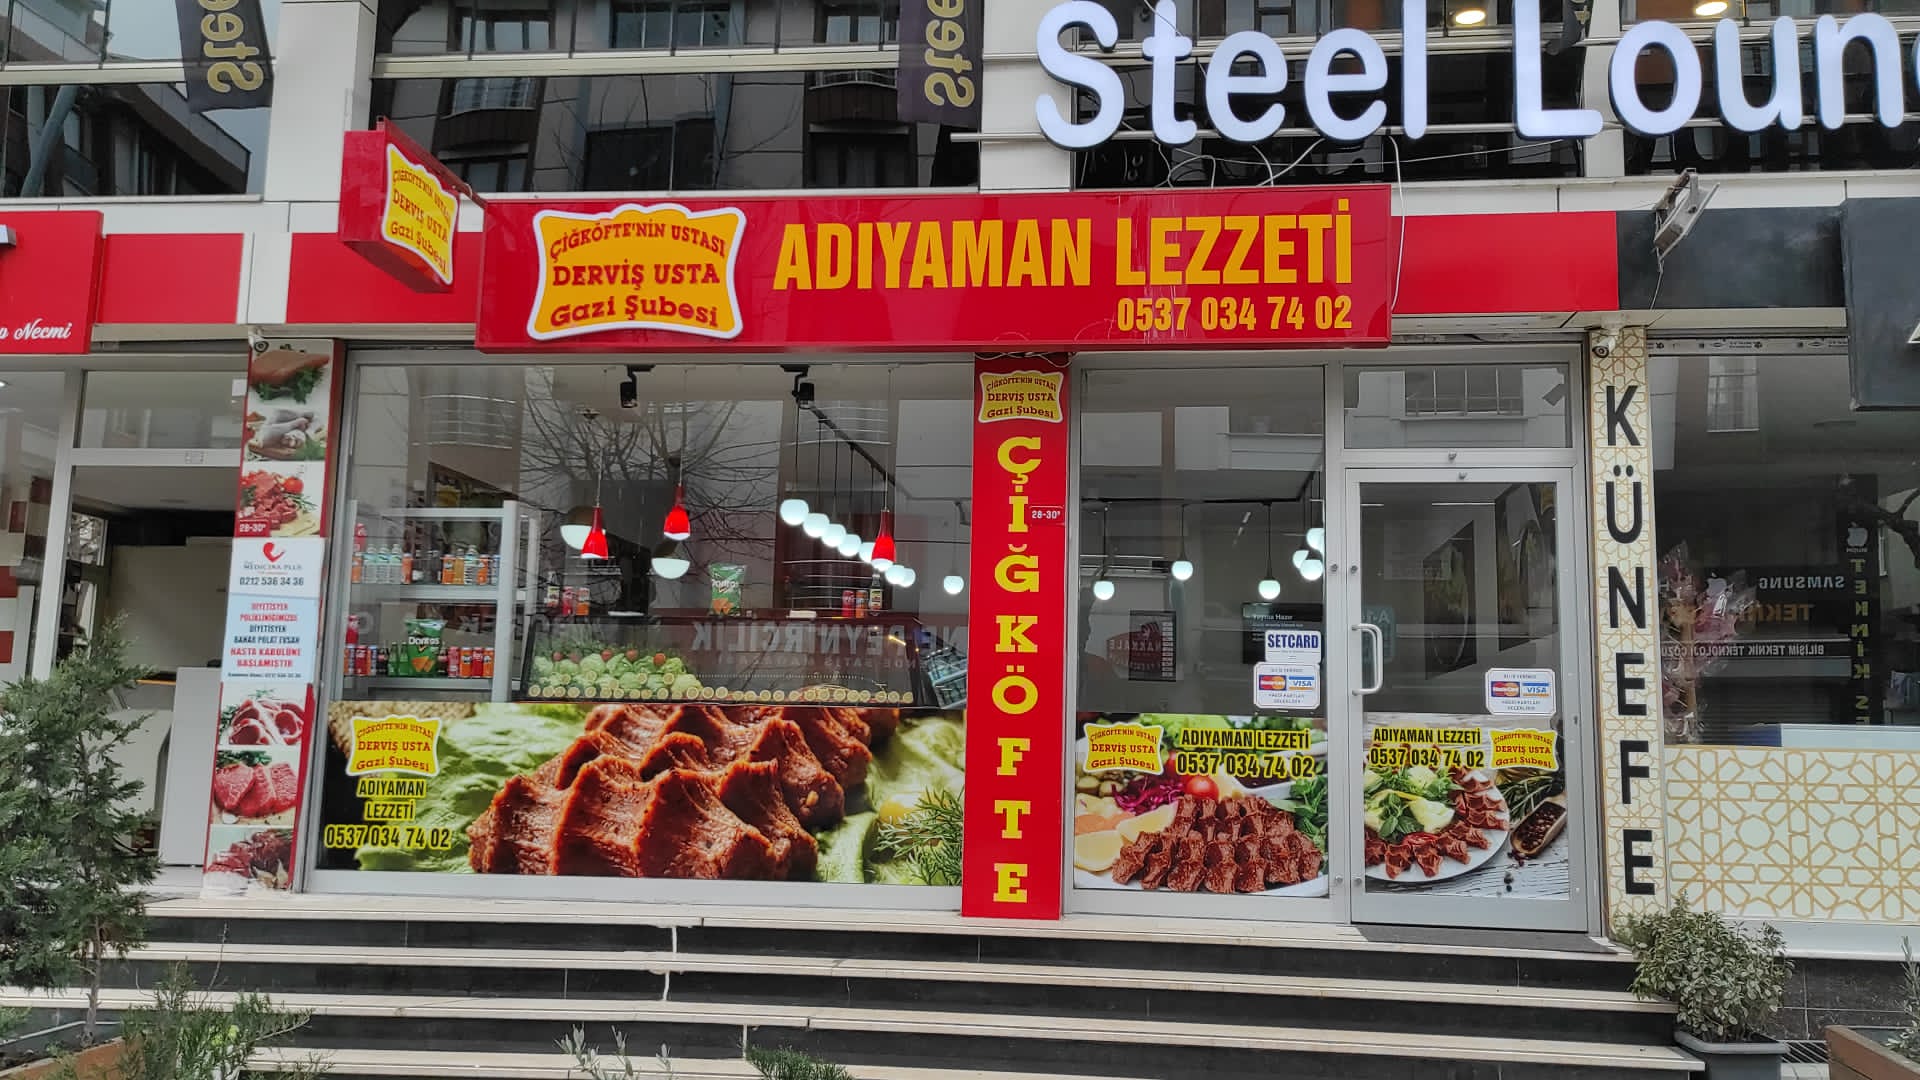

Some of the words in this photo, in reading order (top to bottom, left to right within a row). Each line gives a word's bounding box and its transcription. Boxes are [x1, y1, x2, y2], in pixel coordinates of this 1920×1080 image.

[1035, 0, 1427, 148] Steel
[1512, 0, 1920, 139] Loun
[393, 189, 424, 228] DERVİŞ
[426, 209, 448, 243] USTA
[391, 221, 414, 241] Gazi
[550, 218, 666, 263] ÇİĞKÖFTE'NİN
[671, 223, 726, 259] USTASI
[773, 217, 1092, 290] ADIYAMAN
[1115, 198, 1352, 286] LEZZETİ
[552, 259, 645, 290] DERVİŞ
[654, 263, 720, 285] USTA
[551, 296, 616, 327] Gazi
[625, 295, 719, 327] Şubesi
[1118, 297, 1190, 332] 0537
[1201, 297, 1256, 331] 034
[1267, 296, 1304, 331] 74
[1315, 295, 1352, 330] 02
[14, 318, 73, 341] Necmi
[988, 392, 1024, 404] DERVİŞ
[1028, 393, 1054, 401] USTA
[987, 406, 1013, 419] Gazi
[1016, 405, 1054, 419] Şubesi
[281, 577, 291, 586] 34
[408, 637, 440, 645] Doritos
[1267, 634, 1319, 649] SETCARD
[1606, 384, 1656, 896] KÜNEFE
[992, 436, 1042, 903] ÇİĞKÖFTE
[1182, 730, 1252, 748] ADIYAMAN
[1257, 729, 1310, 748] LEZZETİ
[1374, 728, 1433, 743] ADIYAMAN
[1437, 728, 1481, 744] LEZZETİ
[358, 741, 398, 753] DERVİŞ
[401, 741, 431, 751] USTA
[1092, 743, 1127, 755] DERVİŞ
[1130, 745, 1155, 753] USTA
[1495, 744, 1527, 755] DERVİŞ
[1529, 746, 1551, 754] USTA
[357, 757, 385, 770] Gazi
[389, 756, 429, 771] Şubesi
[1091, 758, 1116, 769] Gazi
[1119, 756, 1154, 770] Şubesi
[1177, 753, 1220, 774] 0537
[1226, 755, 1258, 775] 034
[1264, 756, 1285, 776] 74
[1292, 757, 1313, 777] 02
[1371, 748, 1406, 765] 0537
[1412, 749, 1440, 765] 034
[1444, 750, 1461, 766] 74
[1467, 751, 1484, 767] 02
[1496, 757, 1517, 766] Gazi
[1520, 756, 1551, 768] Şubesi
[359, 780, 425, 796] ADIYAMAN
[366, 800, 414, 819] LEZZETİ
[326, 826, 367, 846] 0537
[370, 827, 399, 846] 034
[406, 828, 425, 847] 74
[430, 828, 450, 848] 02
